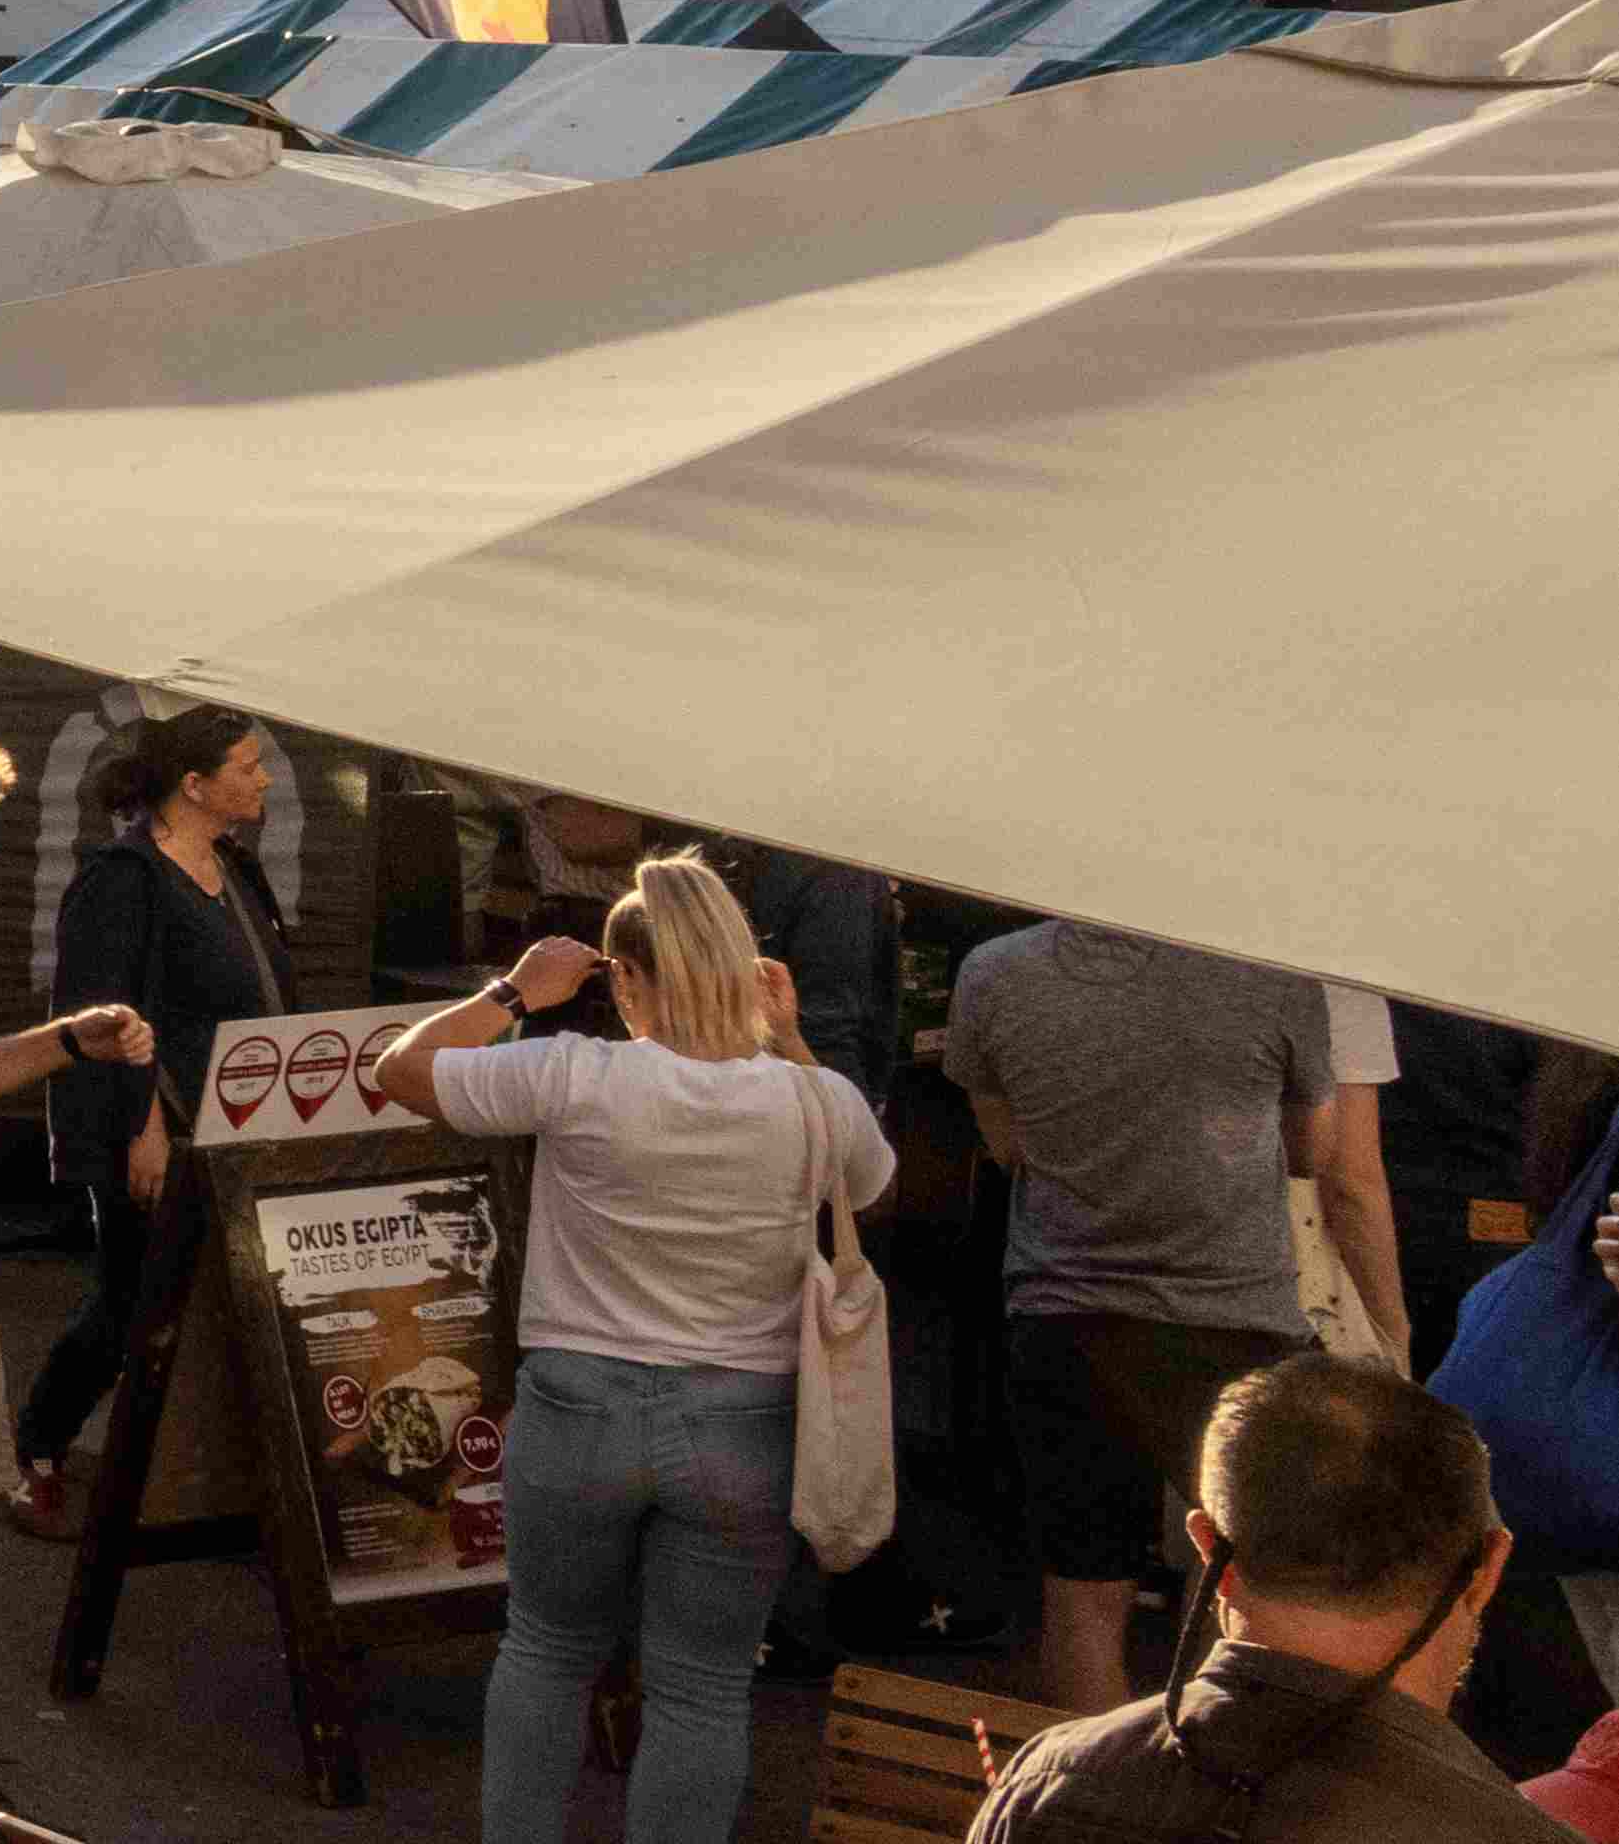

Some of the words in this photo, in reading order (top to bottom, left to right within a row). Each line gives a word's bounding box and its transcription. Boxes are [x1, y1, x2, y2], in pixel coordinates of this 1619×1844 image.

[286, 1221, 348, 1254] OKUS
[352, 1213, 428, 1245] EGIPTA
[289, 1254, 350, 1278] TASTES
[354, 1249, 376, 1272] OF
[382, 1243, 432, 1269] EGYPT
